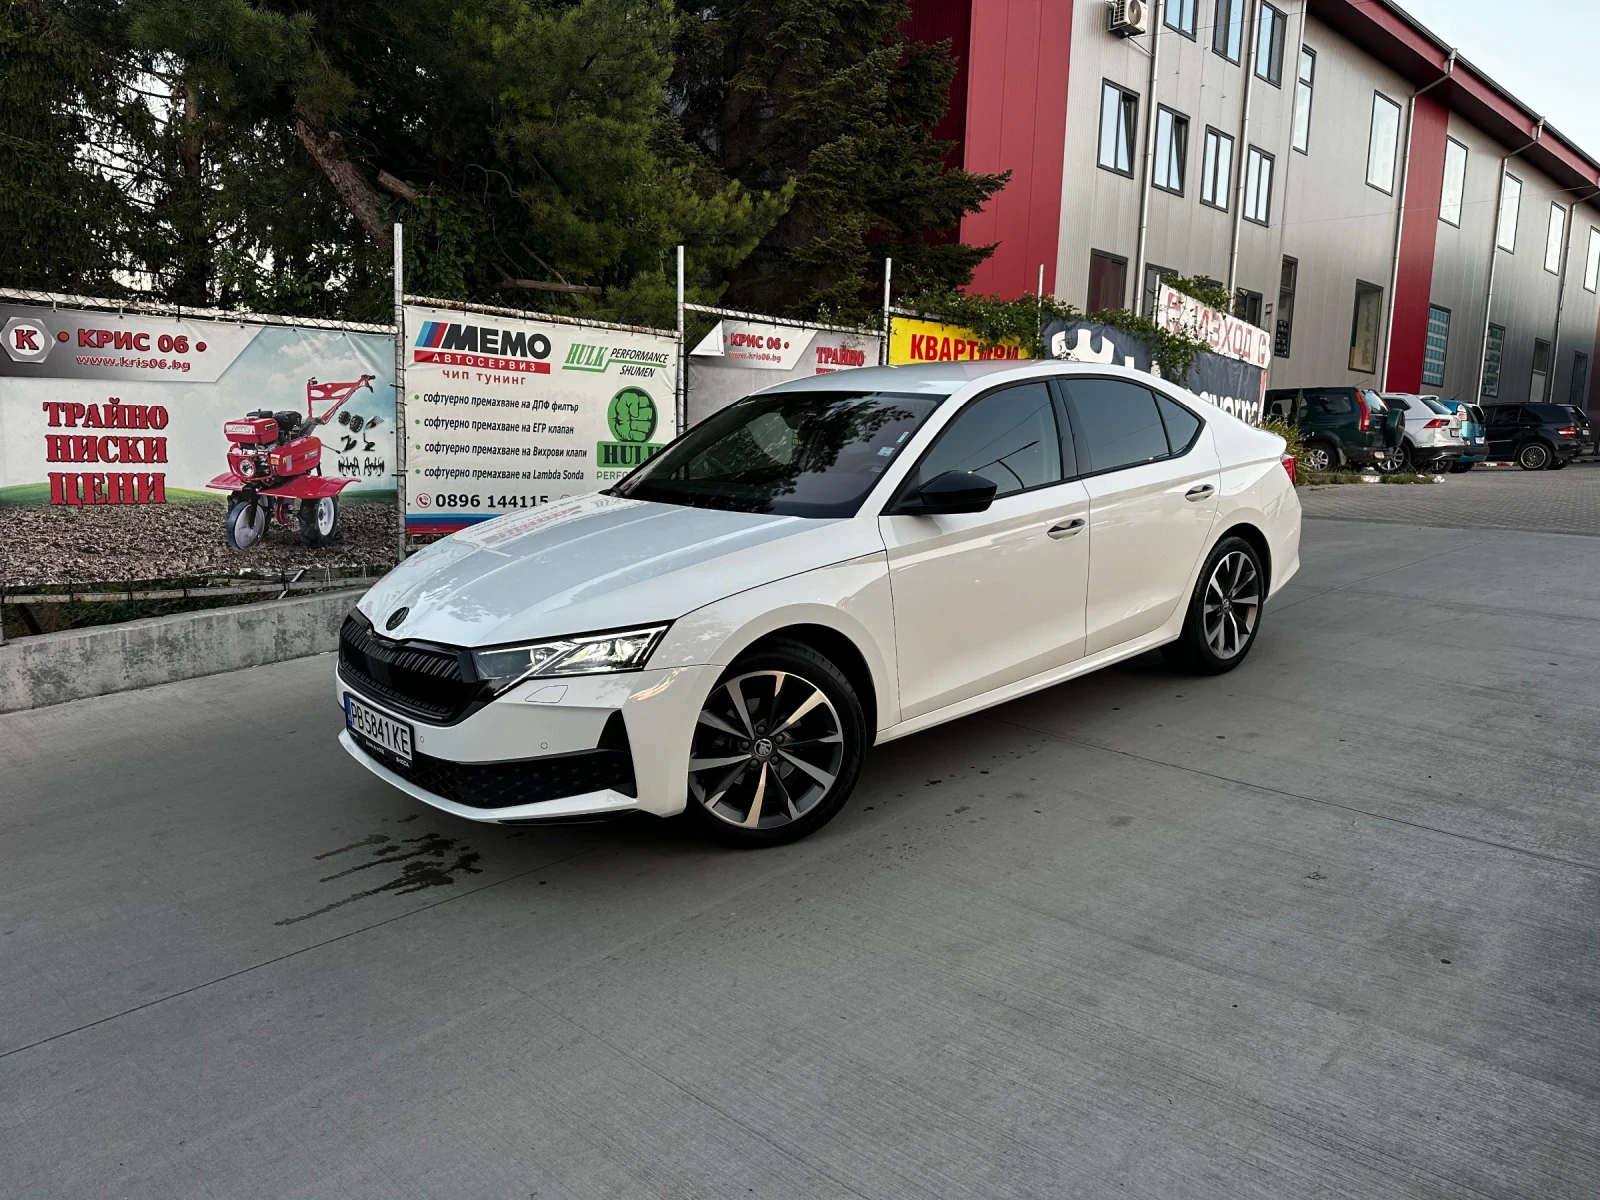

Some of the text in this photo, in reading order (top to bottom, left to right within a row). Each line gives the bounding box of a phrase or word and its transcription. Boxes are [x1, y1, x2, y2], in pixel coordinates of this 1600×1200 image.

[78, 329, 190, 353] КРИС 06
[441, 324, 551, 359] MEMO
[730, 333, 782, 350] КРИС 06
[77, 355, 191, 372] www.kris06.bg
[432, 353, 536, 371] АВТОСЕРВИЗ
[565, 343, 669, 367] HULK PERFORMANCE
[729, 351, 782, 363] www.kris06.bg
[815, 344, 865, 367] ТРАЙНО
[620, 365, 655, 378] SHUMEN
[423, 391, 579, 414] софтуерно премахване на ДПФ филтър
[43, 397, 169, 430] ТРАЙНО
[424, 416, 574, 434] софтуерно премахване на ЕГР клапан
[45, 434, 168, 463] НИСКИ
[424, 441, 588, 459] софтуерно премахване на Вихрови клапи
[424, 466, 584, 480] софтуерно премахване на Lambda Sonda
[47, 472, 167, 509] ЦЕНИ
[435, 494, 549, 508] 0896 144115
[350, 702, 364, 729] PB
[364, 709, 391, 746] 5841
[391, 723, 410, 756] KE
